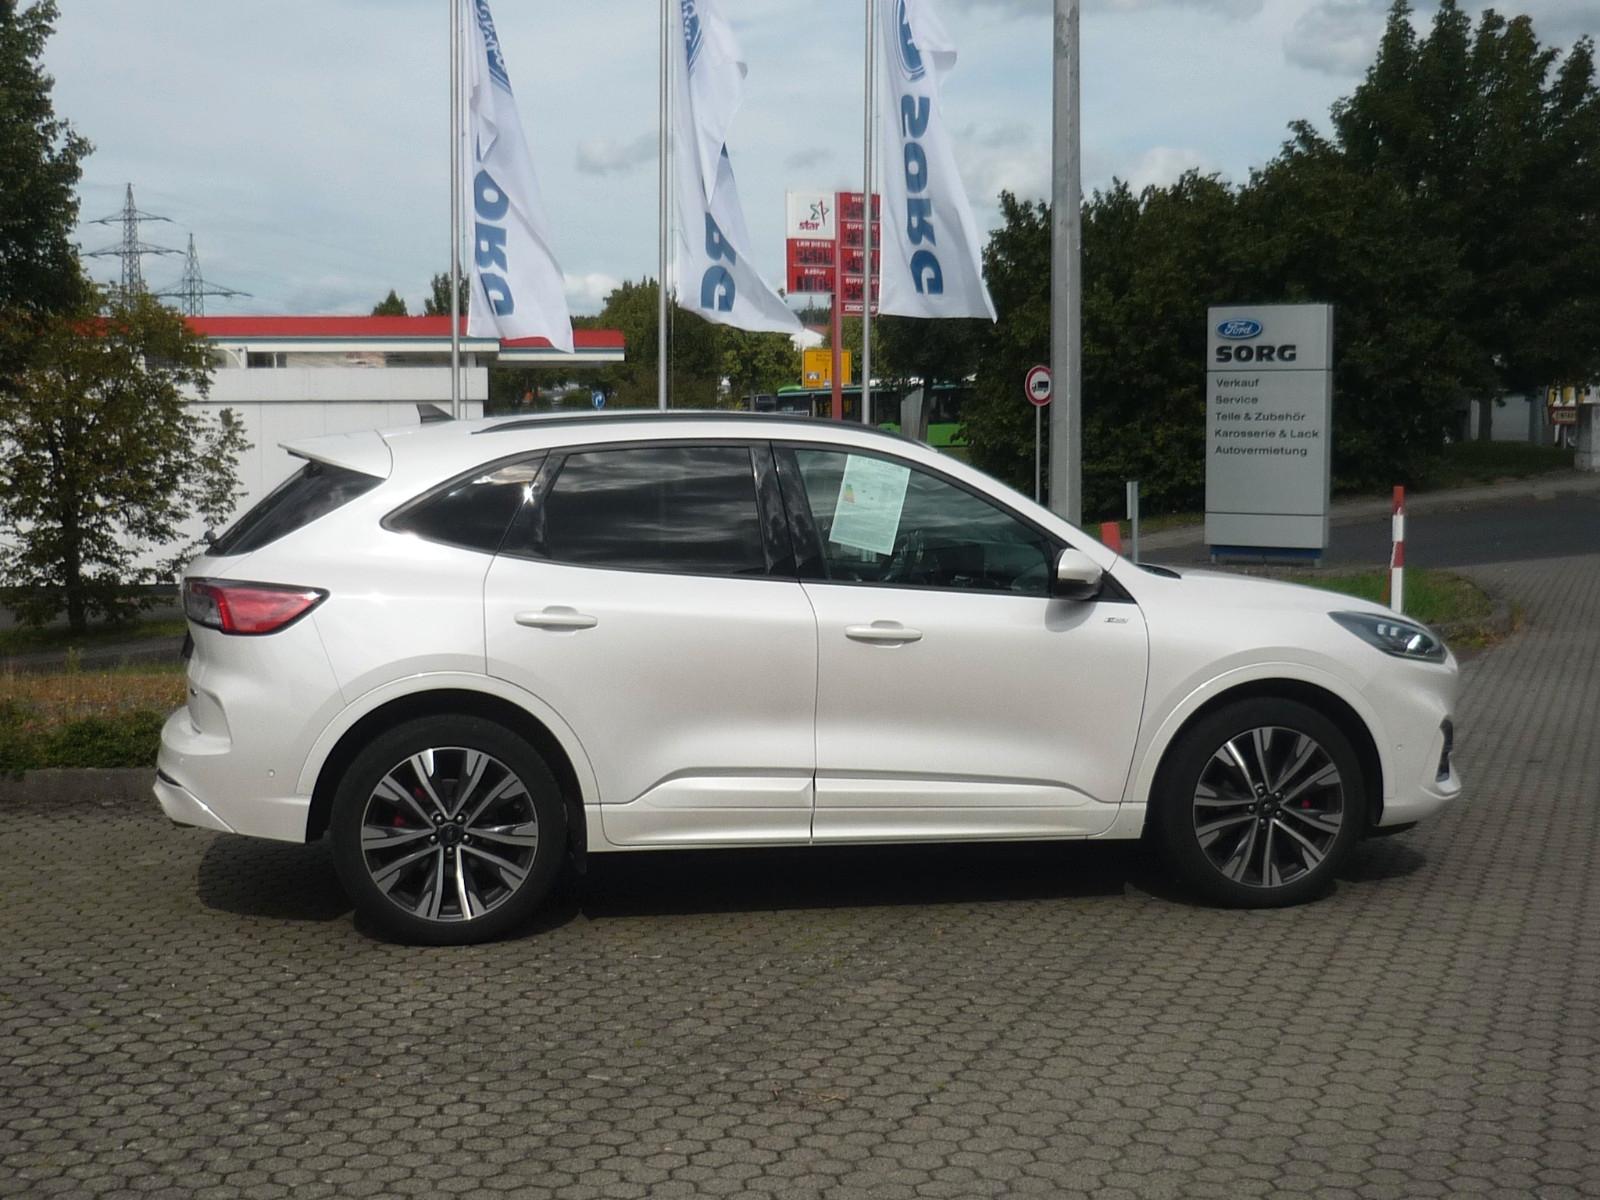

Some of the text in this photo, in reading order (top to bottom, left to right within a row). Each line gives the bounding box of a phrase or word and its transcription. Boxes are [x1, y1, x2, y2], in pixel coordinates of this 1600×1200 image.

[799, 220, 820, 231] star
[1223, 322, 1253, 335] Ford
[1216, 345, 1297, 363] SORG
[1216, 379, 1260, 388] Verkauf
[1215, 395, 1259, 405] Service
[1215, 412, 1306, 421] Teile & Zubehör
[1214, 429, 1319, 438] Karosserie & Lack
[1214, 446, 1308, 457] Autovermietung
